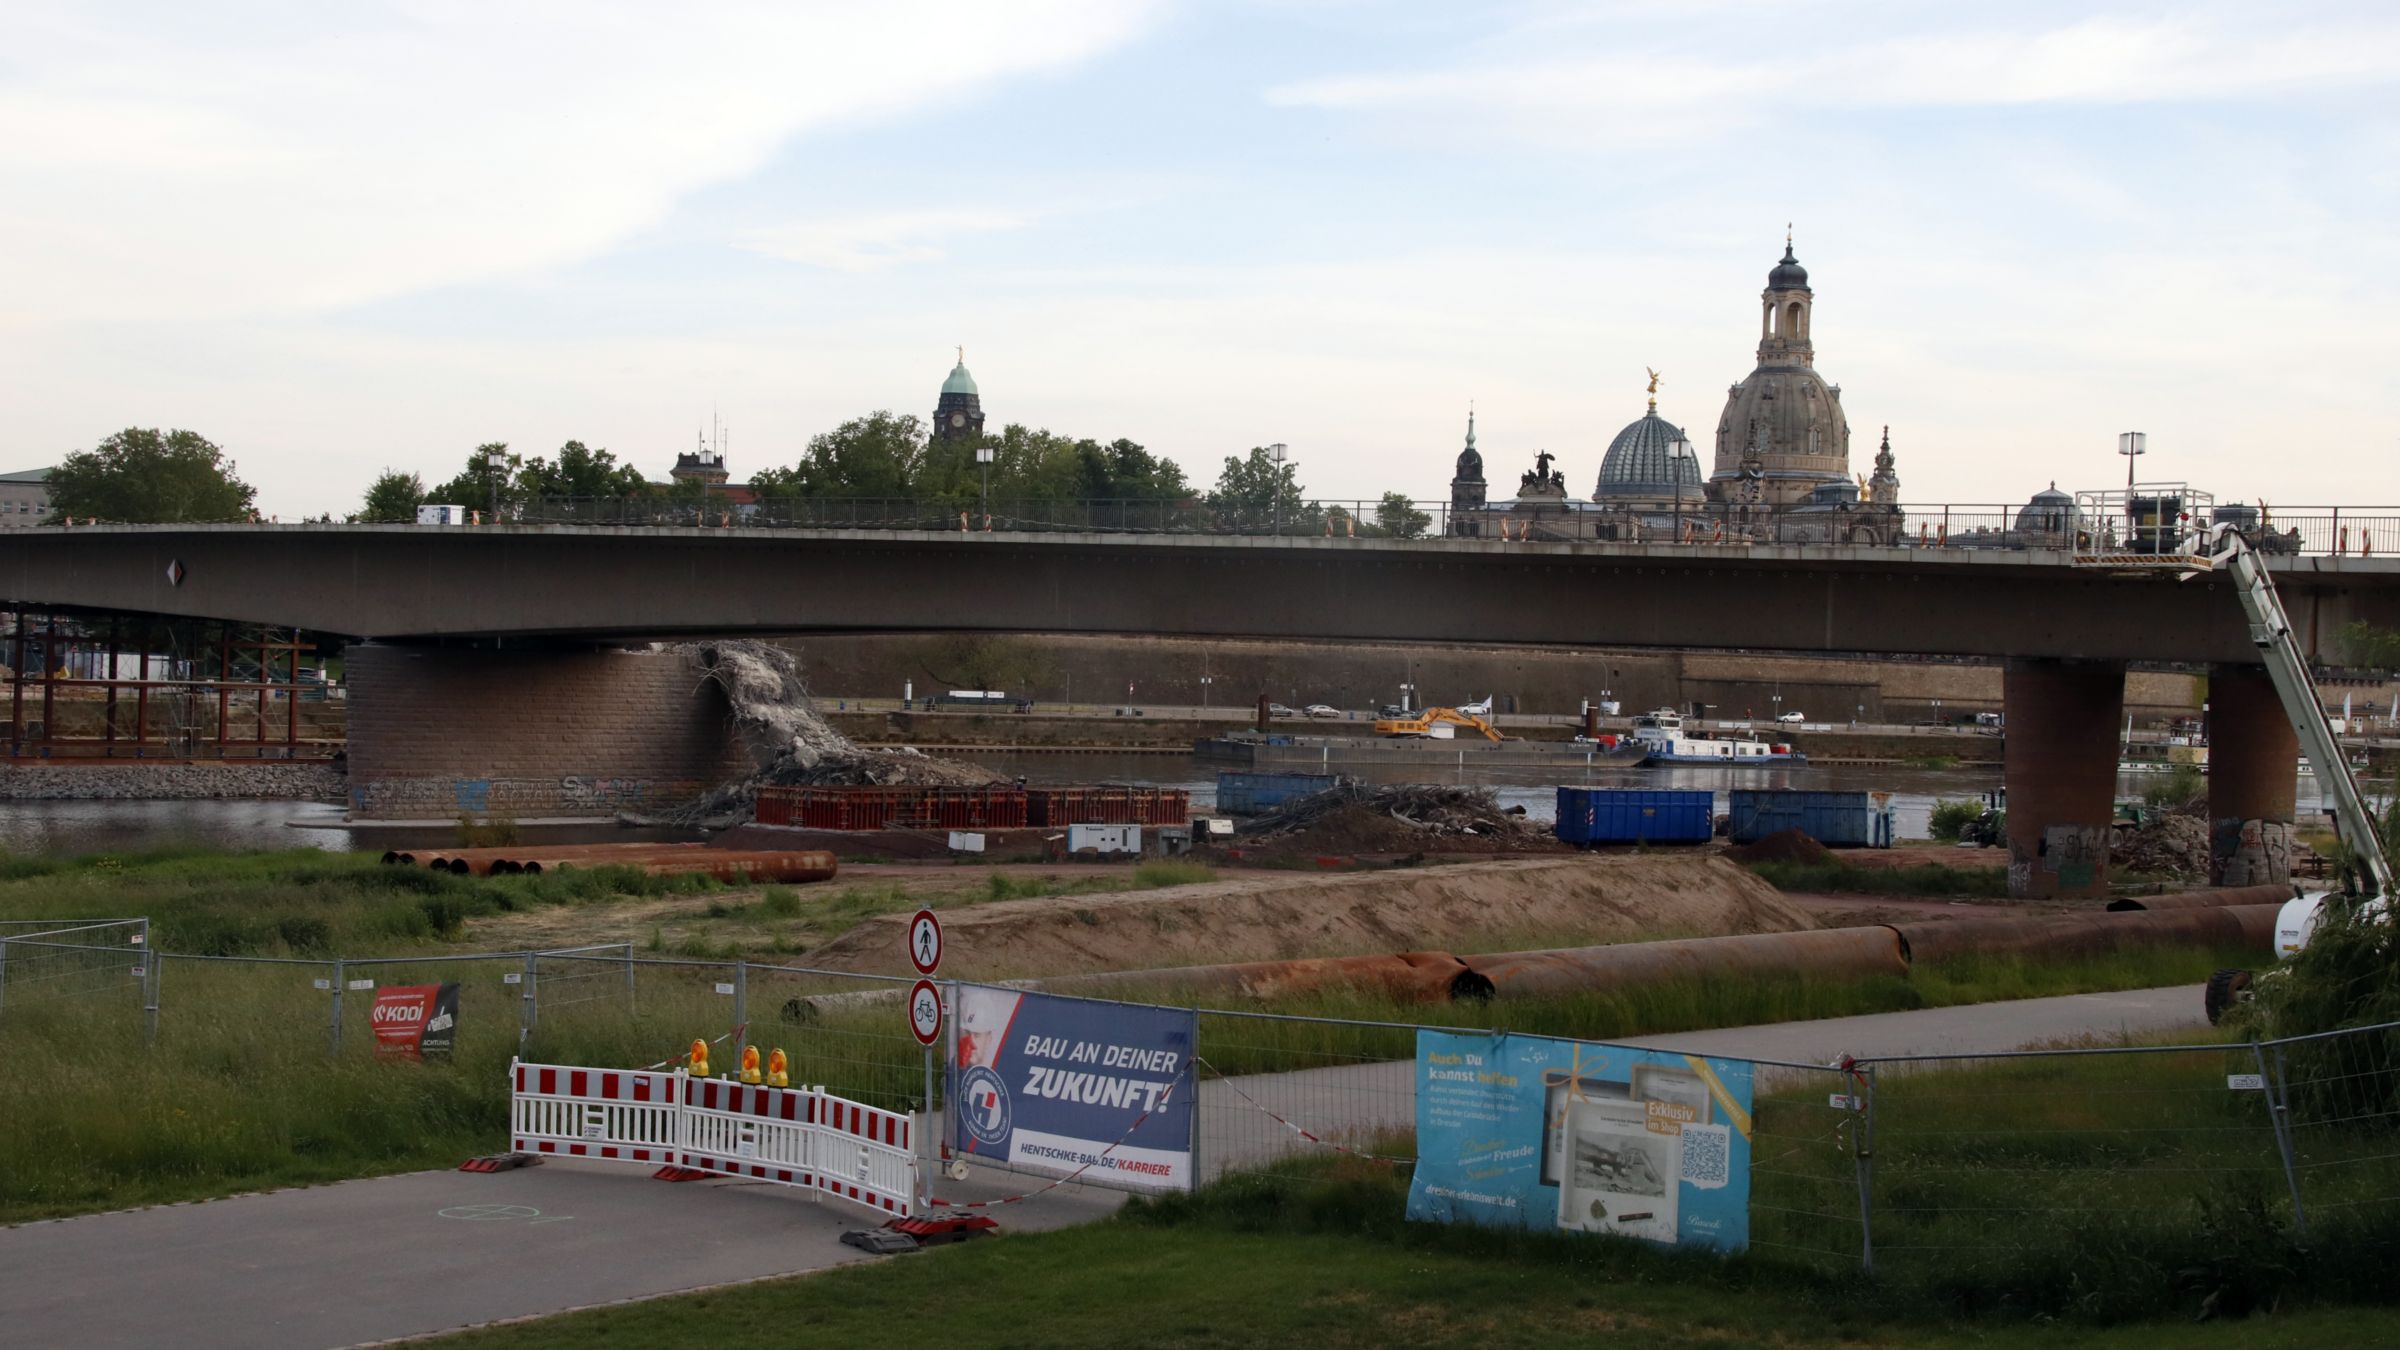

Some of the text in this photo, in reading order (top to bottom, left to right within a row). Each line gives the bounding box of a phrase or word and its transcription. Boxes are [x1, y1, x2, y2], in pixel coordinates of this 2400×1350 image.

[1024, 1034, 1178, 1073] BAU AN DEINER
[1428, 1051, 1461, 1065] Auch
[1429, 1067, 1475, 1082] kannst
[1022, 1066, 1176, 1114] ZUKUNFT!
[1648, 1101, 1694, 1121] Exklusiv
[1648, 1119, 1659, 1130] im
[1660, 1120, 1679, 1136] Shop
[1020, 1142, 1173, 1177] HENTSCHKE-BAU.DE/KARRIERE
[1493, 1145, 1535, 1162] Freude
